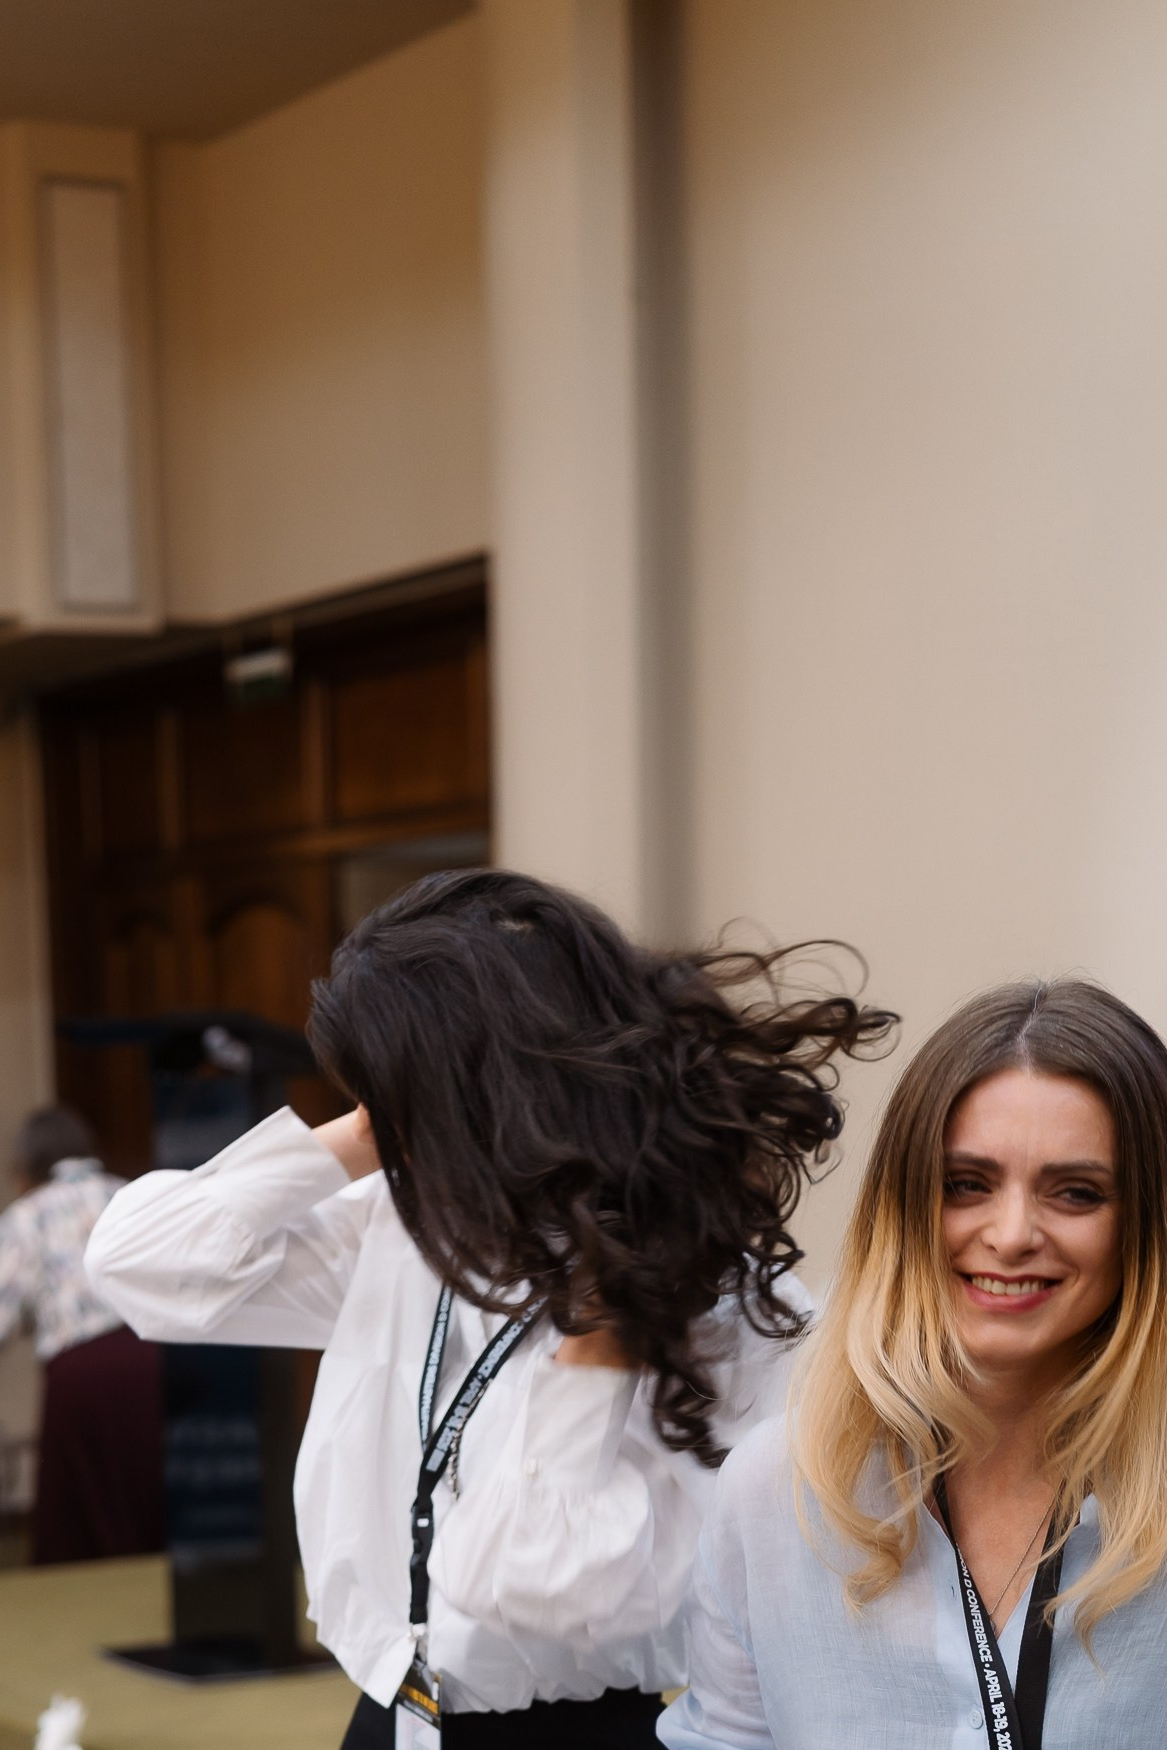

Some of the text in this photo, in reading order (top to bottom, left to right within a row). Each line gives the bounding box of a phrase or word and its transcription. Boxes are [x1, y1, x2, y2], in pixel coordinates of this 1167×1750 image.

[963, 1578, 972, 1588] D
[966, 1587, 994, 1662] CONFERENCE
[983, 1668, 1003, 1702] APRIL
[991, 1701, 1009, 1732] 18-19,
